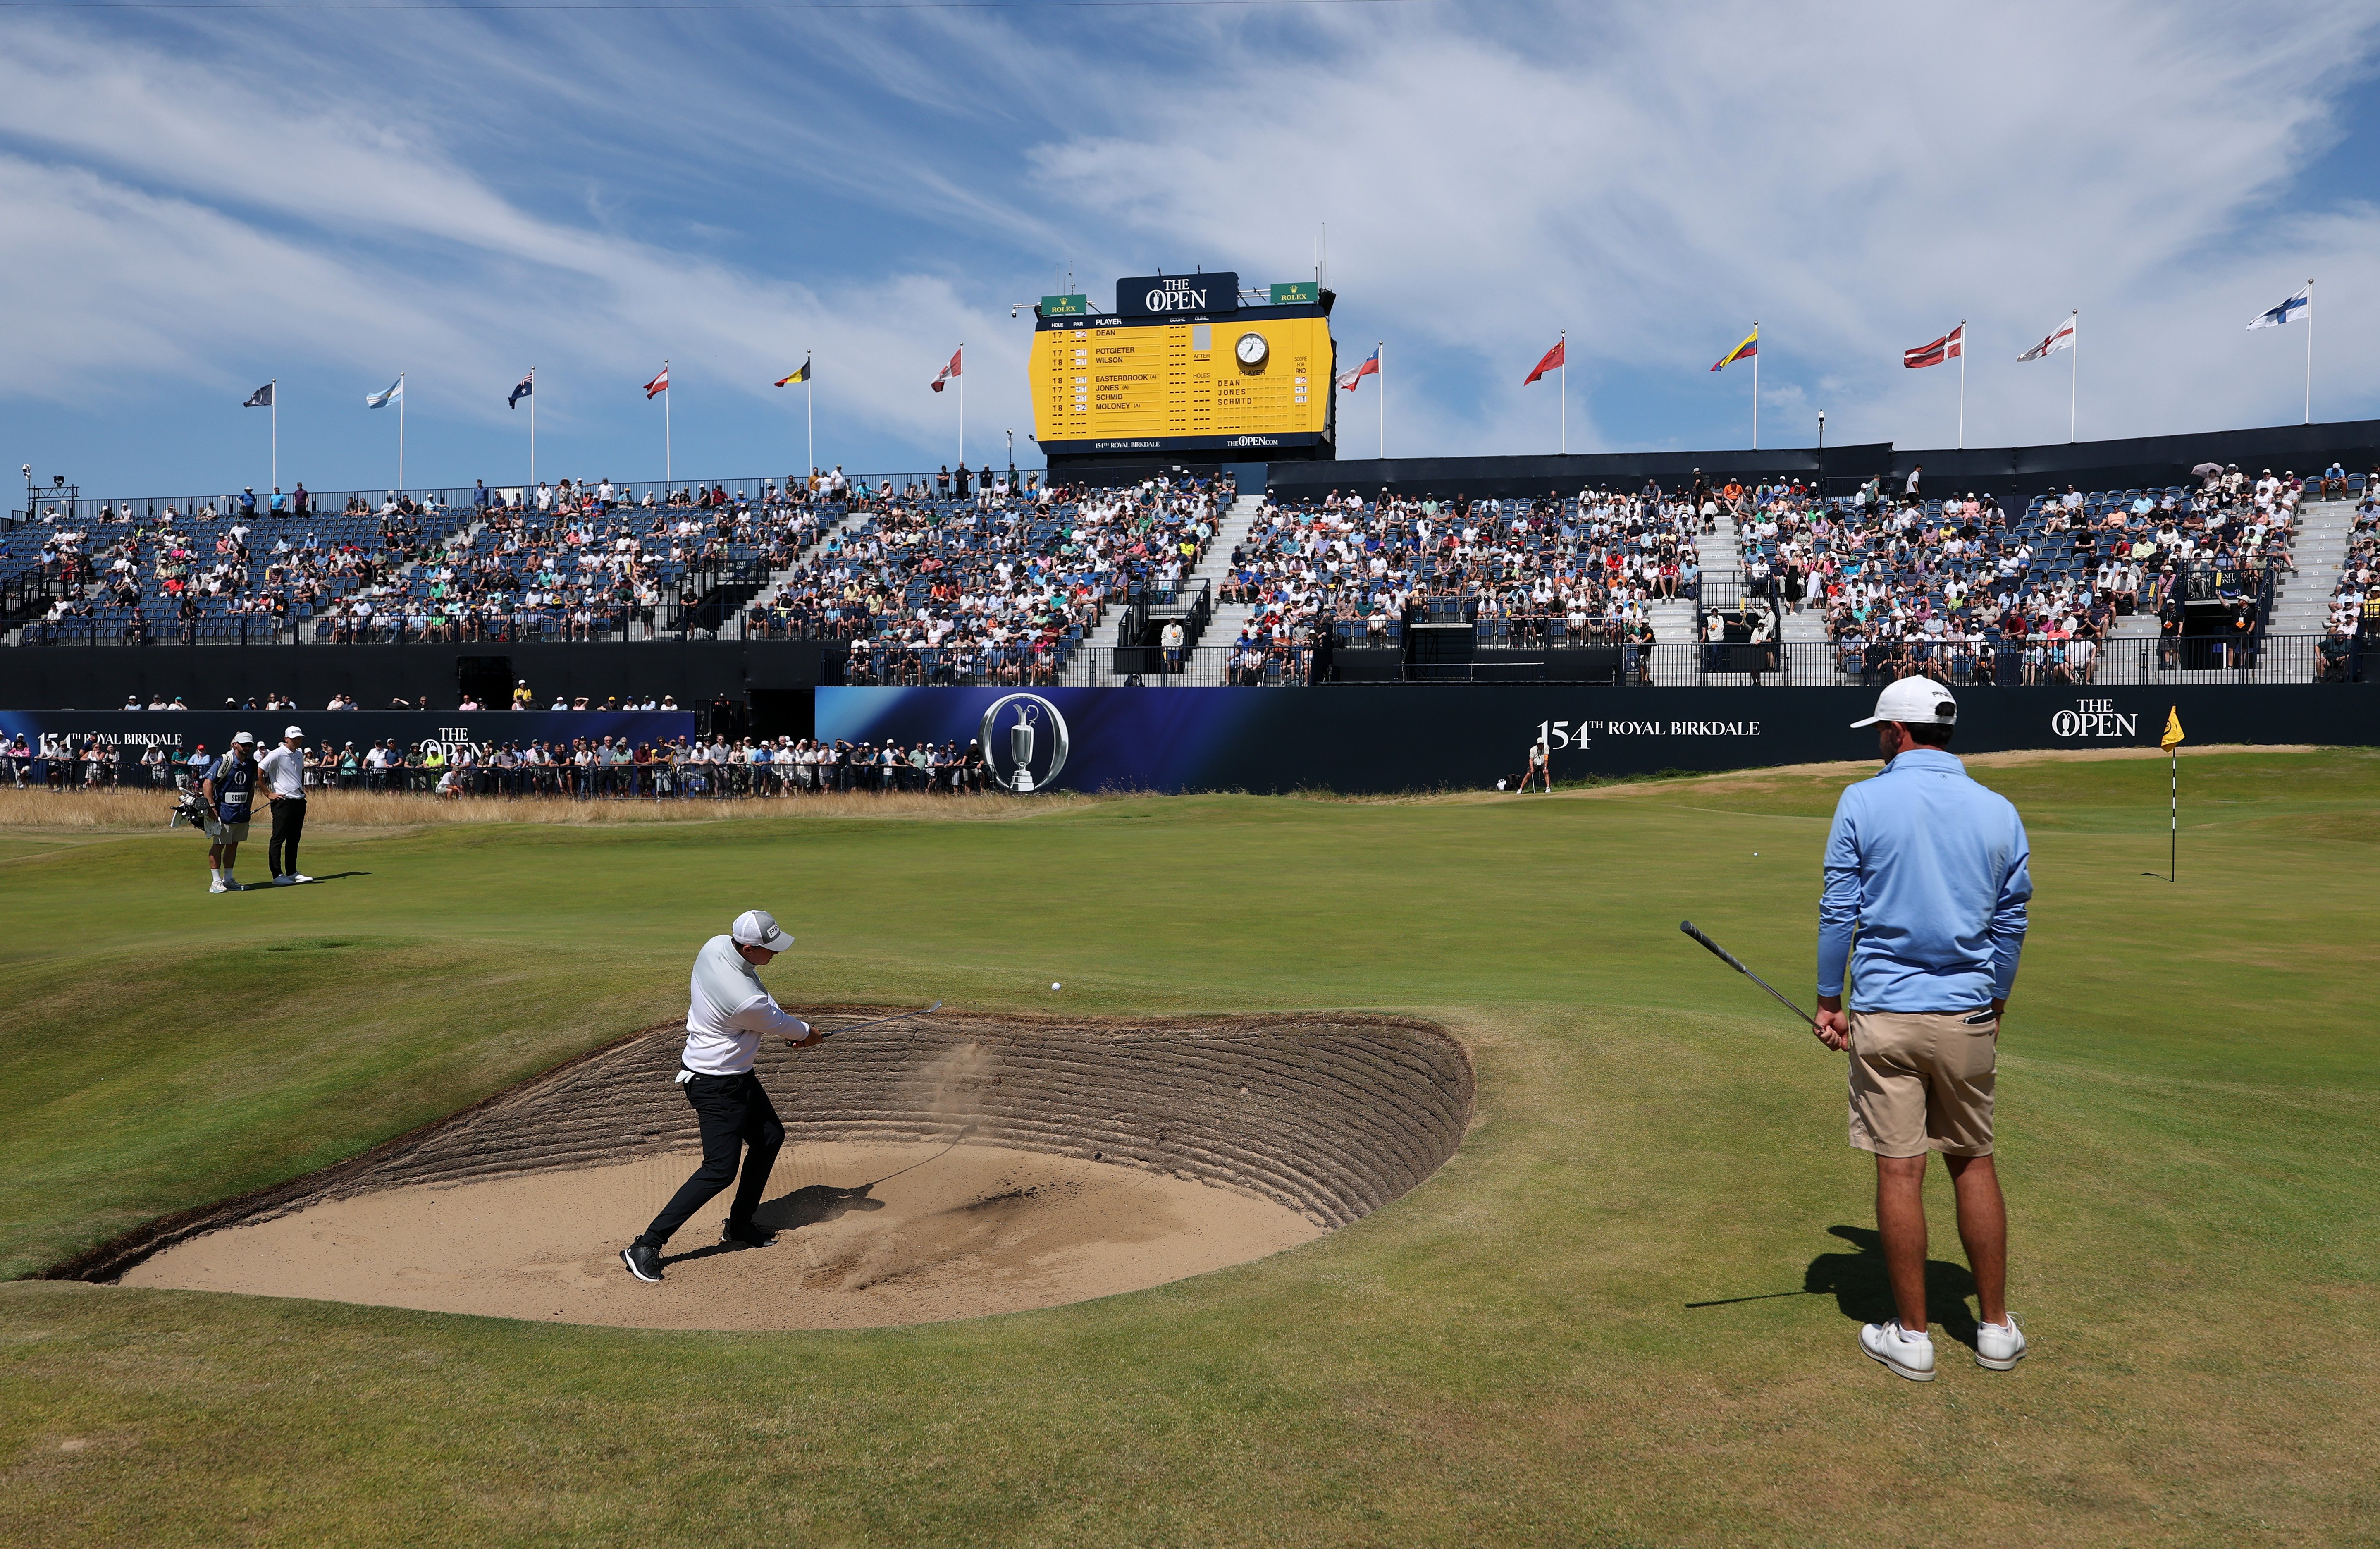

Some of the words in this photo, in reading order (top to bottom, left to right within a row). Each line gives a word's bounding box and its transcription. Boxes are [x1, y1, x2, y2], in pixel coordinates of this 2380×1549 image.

[1163, 279, 1189, 290] THE
[1146, 289, 1207, 312] OPEN
[2076, 699, 2113, 712] THE
[2051, 710, 2138, 737] OPEN
[124, 734, 182, 745] BIRKDALE
[438, 727, 468, 741] THE
[1537, 720, 1603, 750] 154TH
[1608, 721, 1666, 735] ROYAL
[1671, 722, 1760, 736] BIRKDALE
